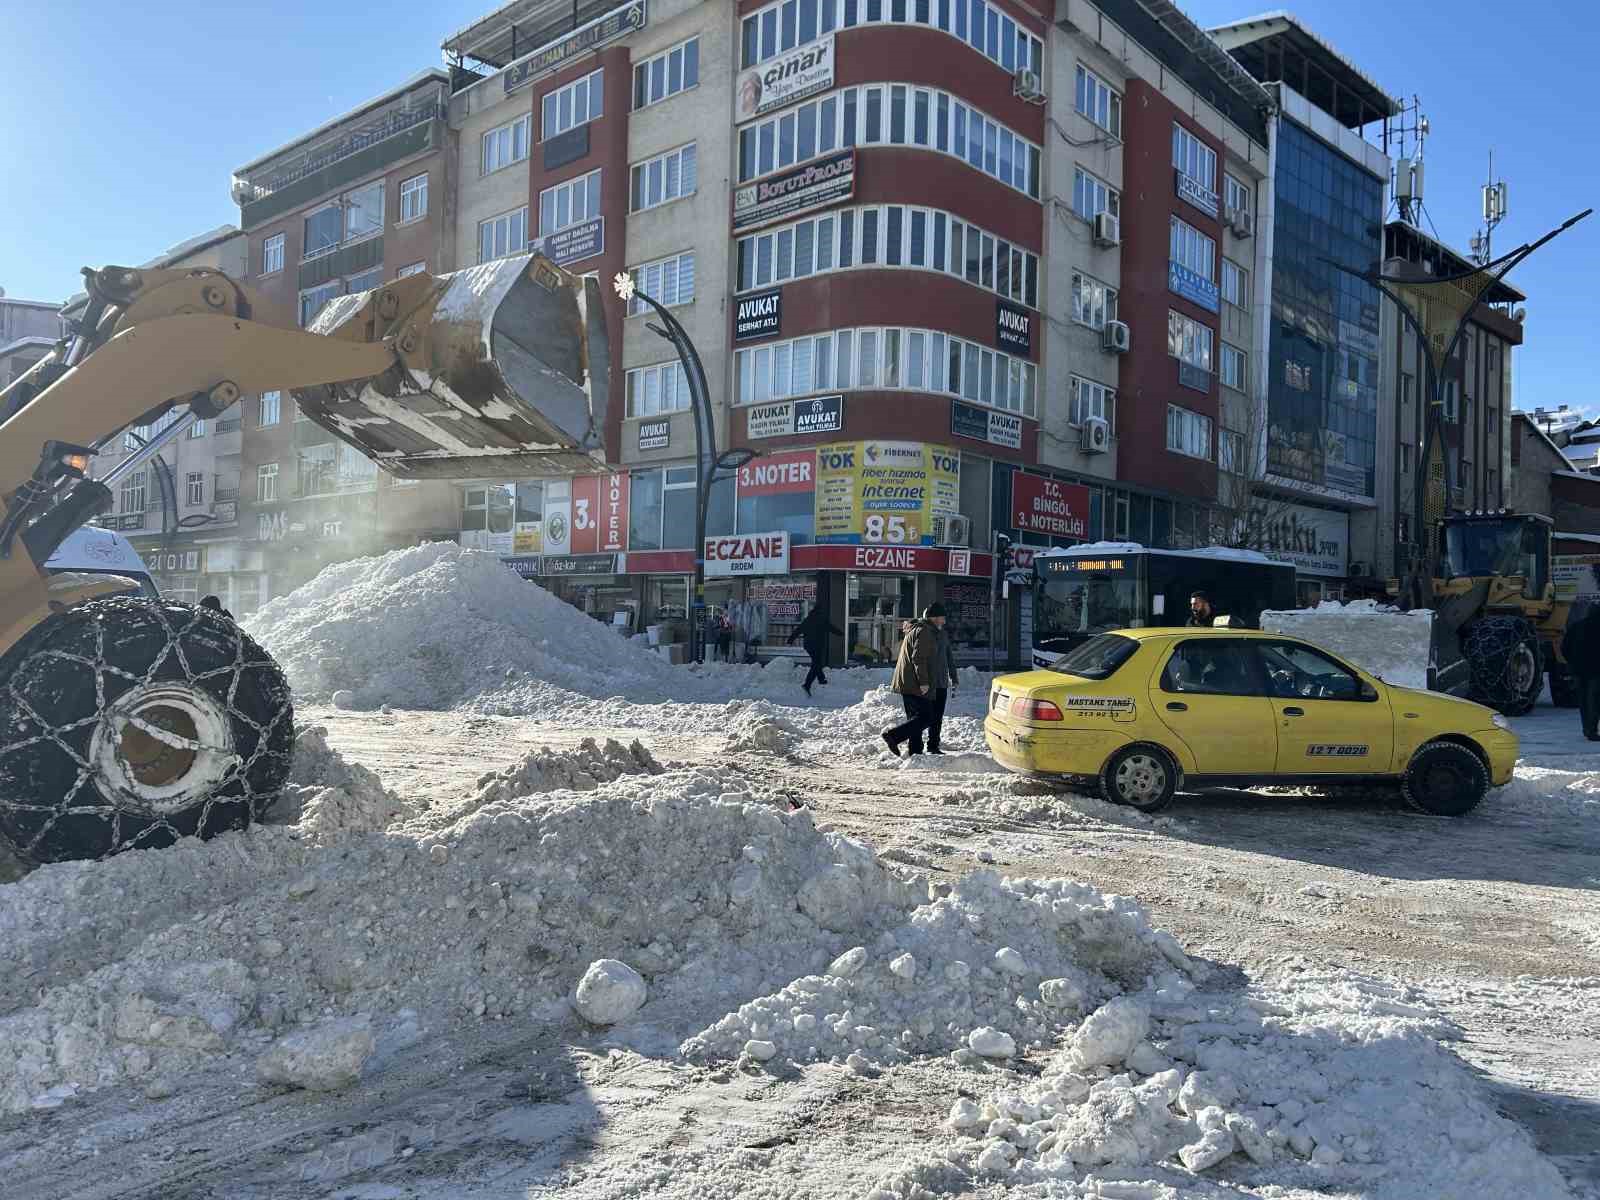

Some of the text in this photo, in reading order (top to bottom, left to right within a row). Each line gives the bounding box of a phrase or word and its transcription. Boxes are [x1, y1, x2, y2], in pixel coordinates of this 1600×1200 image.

[738, 296, 779, 321] AVUKAT
[999, 308, 1029, 333] AVUKAT
[752, 405, 790, 420] AVUKAT
[798, 411, 837, 425] AVUKAT
[640, 423, 668, 438] AVUKAT
[991, 415, 1019, 431] AVUKAT
[820, 453, 856, 470] YOK
[932, 455, 959, 473] YOK
[862, 484, 926, 498] internet
[1044, 481, 1062, 498] T.C.
[574, 499, 596, 530] 3.
[609, 475, 620, 544] NOTER
[1033, 496, 1072, 517] BİNGÖL
[865, 515, 906, 543] 85
[1018, 511, 1084, 537] 3. NOTERLİĞİ
[705, 536, 783, 561] ECZANE
[731, 562, 754, 571] ERDEM
[856, 547, 916, 569] ECZANE
[1067, 698, 1105, 707] HASTANE
[1311, 746, 1325, 755] 12
[1327, 746, 1336, 755] T
